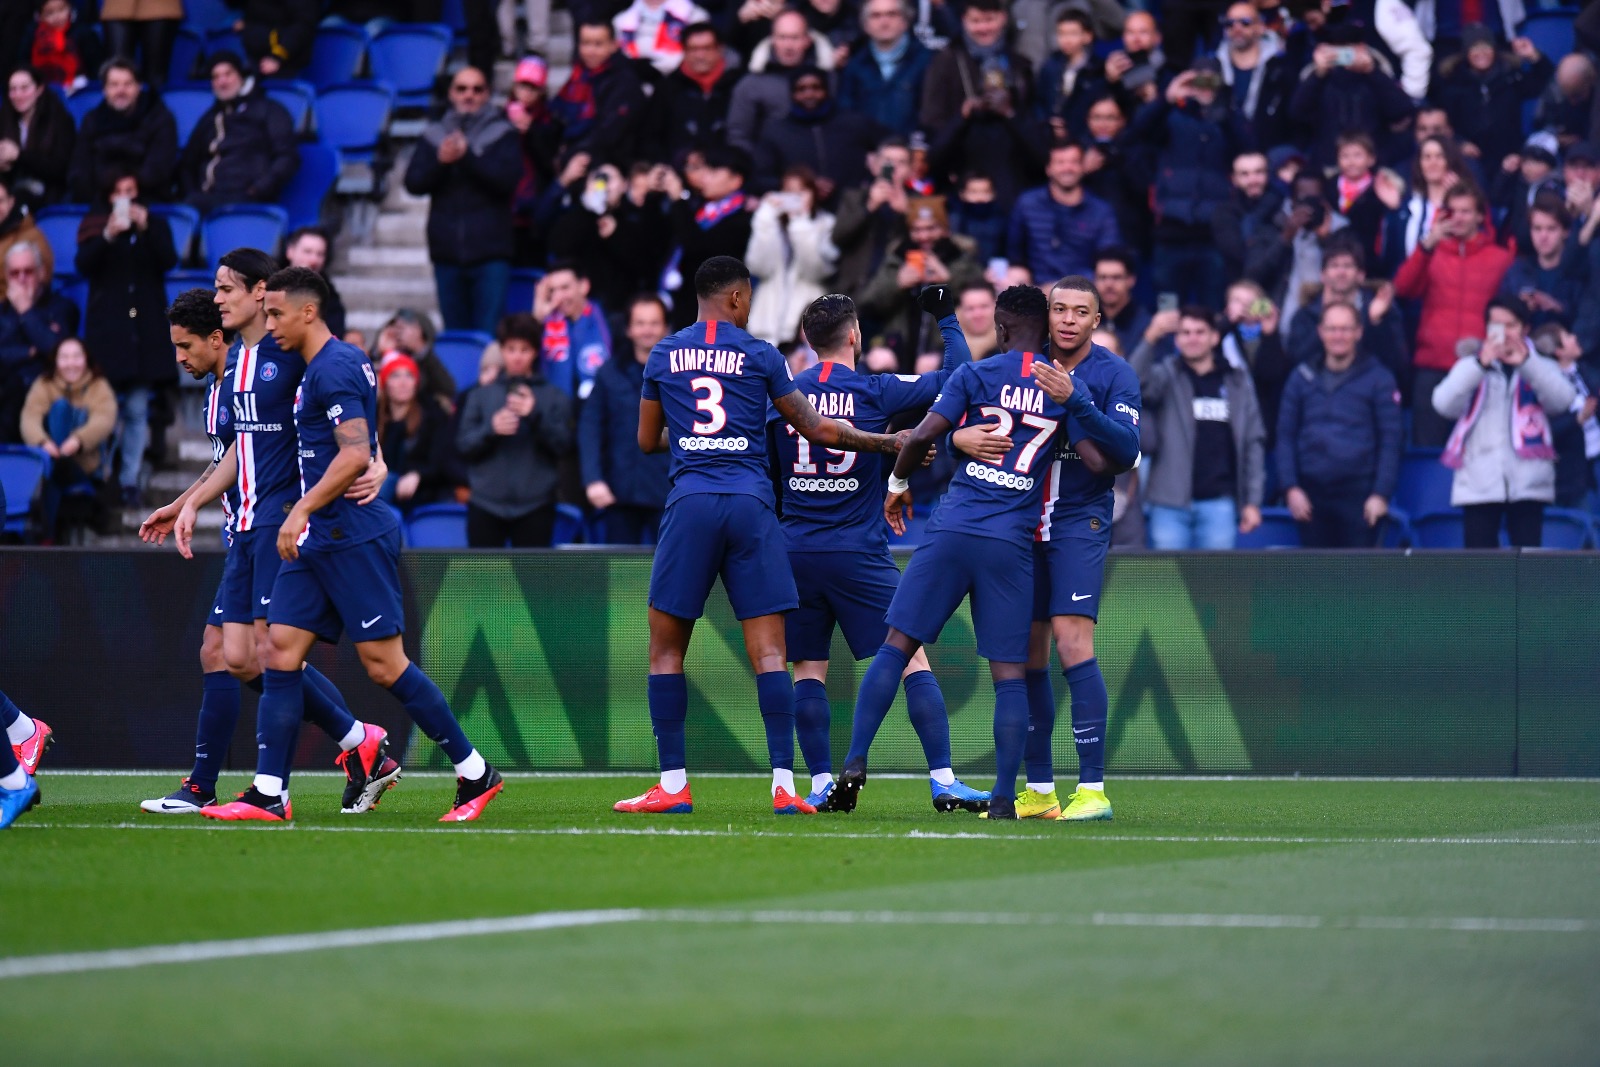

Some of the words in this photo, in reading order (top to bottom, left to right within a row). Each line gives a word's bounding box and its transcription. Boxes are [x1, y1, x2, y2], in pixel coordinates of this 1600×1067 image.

[670, 348, 746, 375] KIMPEMBE
[326, 404, 343, 420] NB
[690, 376, 727, 435] 3
[808, 392, 855, 416] RABIA
[1000, 384, 1044, 414] GANA
[1115, 403, 1139, 419] QNB
[678, 437, 749, 450] ooredoo
[786, 418, 857, 474] 19
[980, 406, 1058, 474] 27
[789, 477, 859, 491] ooredoo
[966, 462, 1034, 491] ooredoo
